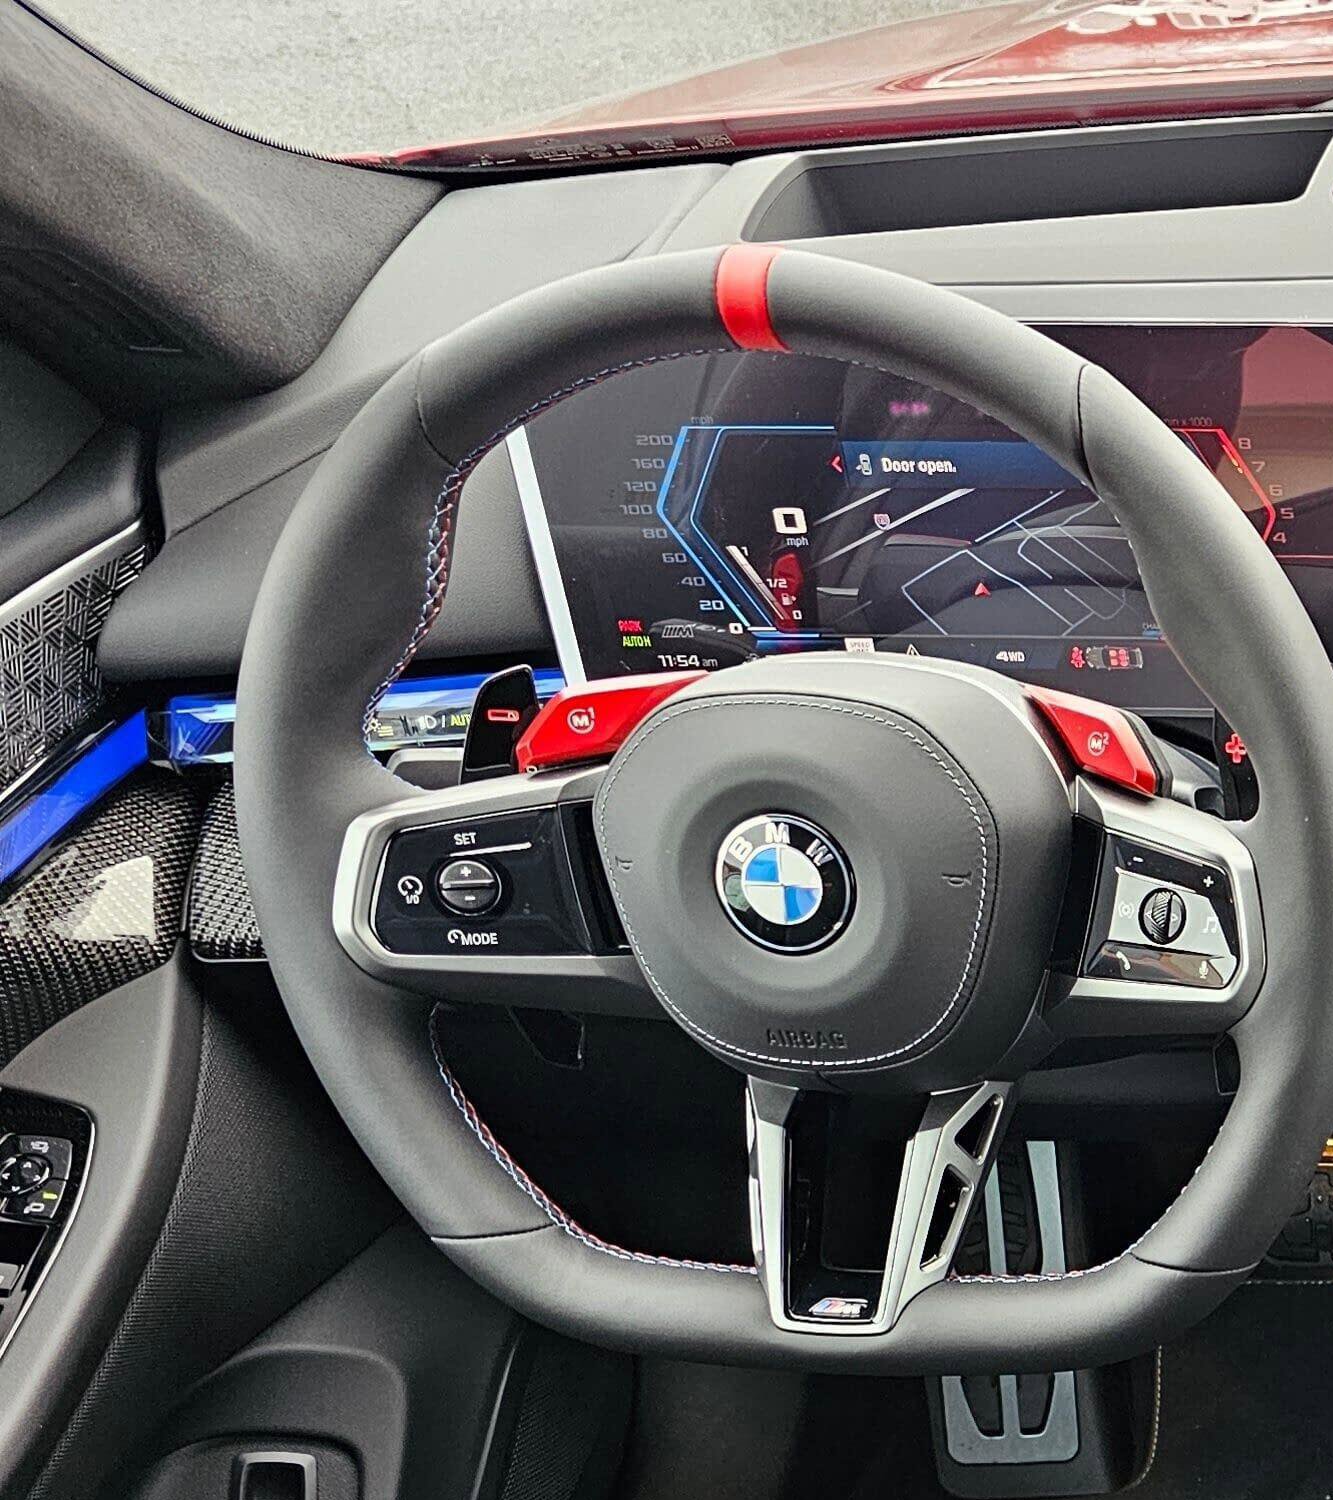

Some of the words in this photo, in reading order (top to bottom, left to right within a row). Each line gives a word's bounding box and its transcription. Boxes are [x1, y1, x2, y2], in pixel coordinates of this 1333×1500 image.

[690, 415, 714, 425] mph
[636, 434, 673, 446] 200
[1238, 437, 1251, 449] 8
[631, 458, 665, 469] 160
[881, 457, 915, 473] Door
[917, 460, 957, 476] open.
[1251, 461, 1265, 473] 7
[623, 481, 657, 492] 120
[1269, 485, 1283, 497] 6
[619, 504, 653, 515] 100
[1280, 508, 1294, 519] 5
[772, 507, 808, 534] 0
[642, 528, 668, 539] 80
[1273, 532, 1287, 544] 4
[786, 536, 809, 548] mph
[661, 552, 687, 563] 60
[740, 547, 749, 557] 1
[681, 576, 706, 587] 40
[766, 578, 788, 589] 1/2
[698, 600, 725, 611] 20
[792, 610, 803, 620] 0
[618, 620, 643, 632] PARK
[728, 622, 744, 634] 0
[622, 636, 644, 647] AUTO
[657, 655, 700, 667] 11:54
[702, 659, 718, 667] am
[995, 651, 1026, 662] 4WD
[450, 713, 471, 726] AUT
[453, 832, 477, 846] SET
[728, 822, 834, 867] BMW
[461, 932, 499, 945] MODE
[765, 1029, 848, 1049] AIRBAG
